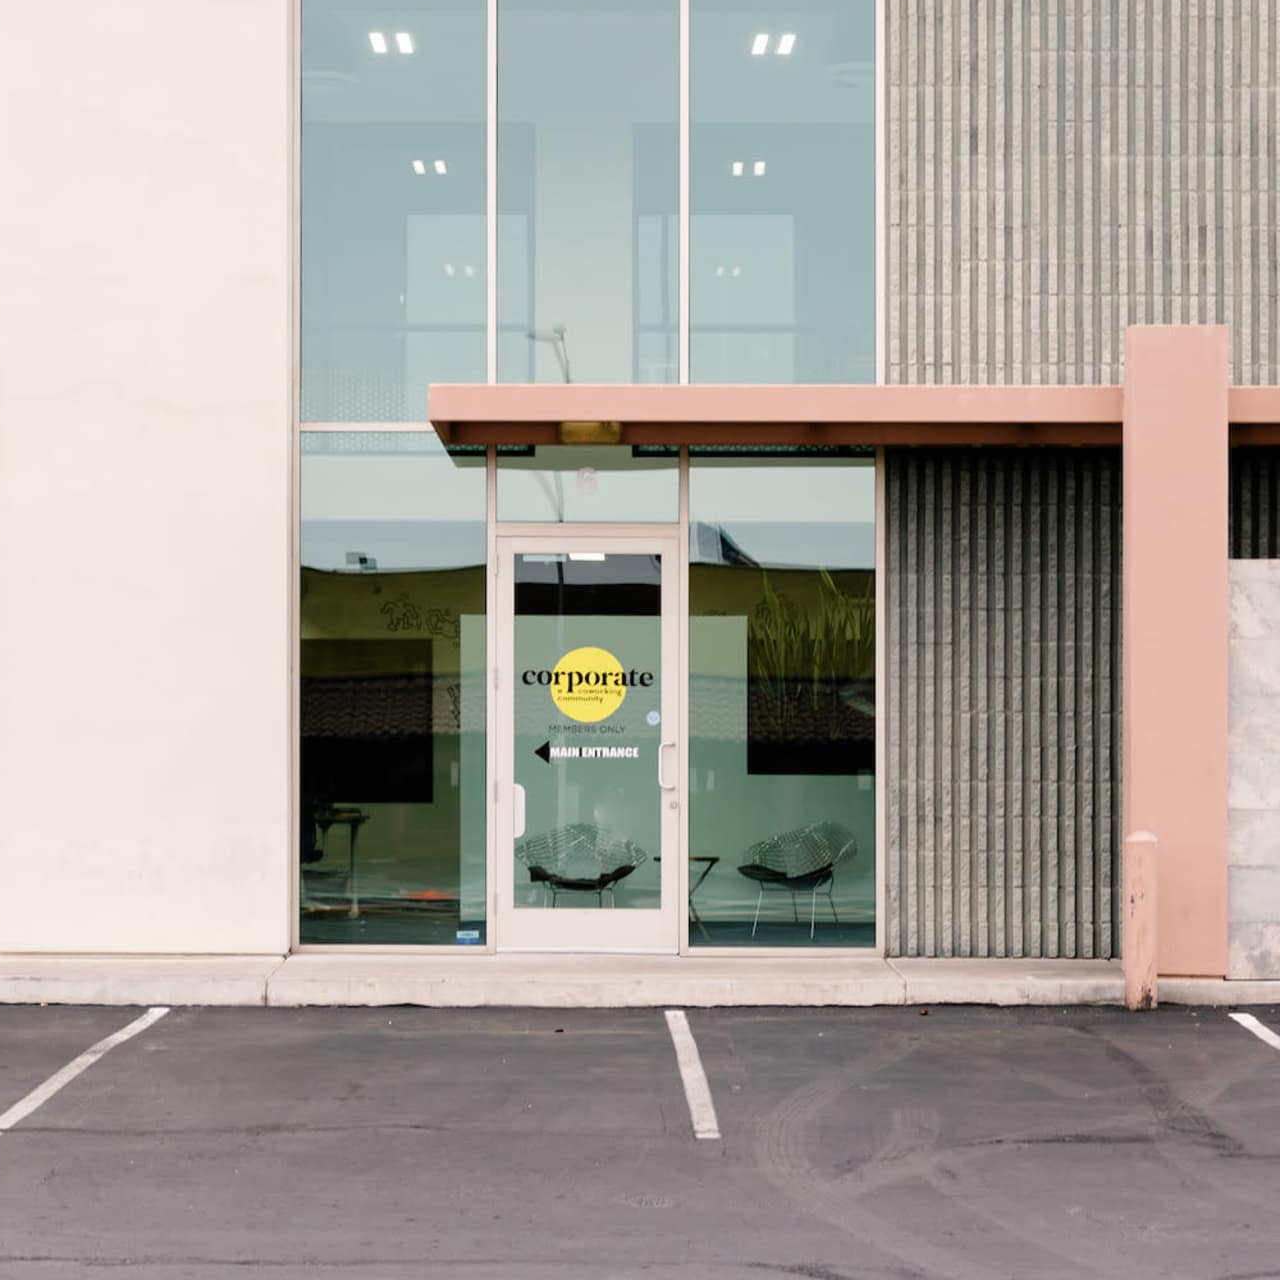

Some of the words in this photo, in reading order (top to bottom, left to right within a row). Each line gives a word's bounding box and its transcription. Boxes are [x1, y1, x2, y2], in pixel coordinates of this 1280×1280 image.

[522, 668, 654, 693] corporate
[577, 688, 622, 697] coworking
[548, 724, 598, 734] MEMBERS
[599, 724, 626, 734] ONLY
[550, 746, 580, 758] MAIN
[581, 746, 640, 758] ENTRANCE
